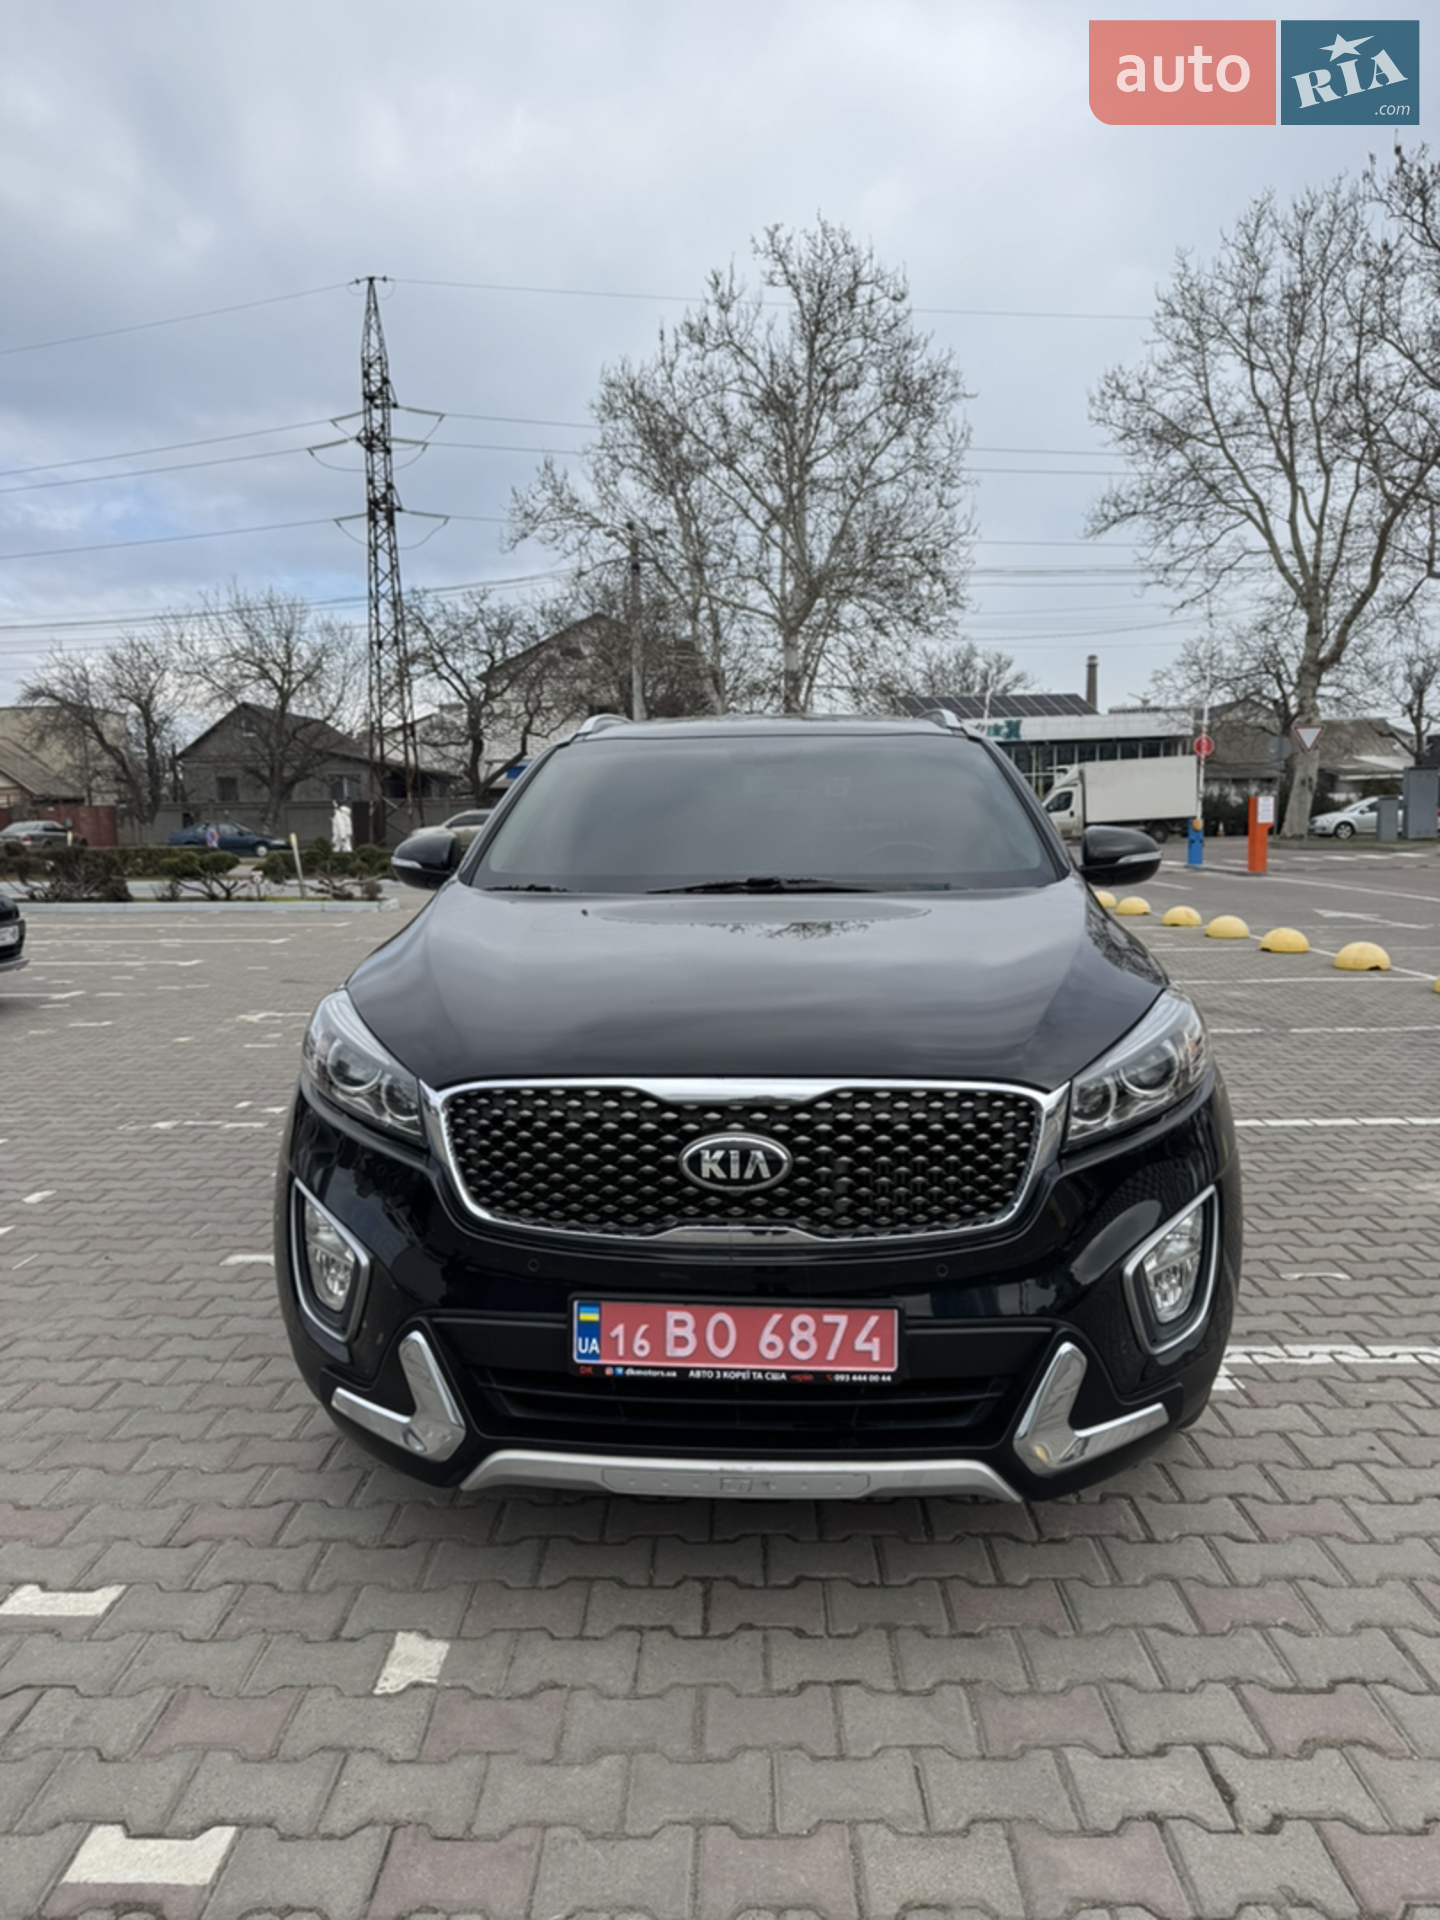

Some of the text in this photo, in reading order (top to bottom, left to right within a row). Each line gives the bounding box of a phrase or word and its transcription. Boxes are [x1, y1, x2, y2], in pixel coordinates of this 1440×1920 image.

[699, 1149, 771, 1179] KIA
[578, 1337, 600, 1354] UA
[609, 1323, 651, 1358] 16
[758, 1313, 881, 1363] 6874
[688, 1368, 714, 1379] АВТО
[764, 1371, 788, 1381] США
